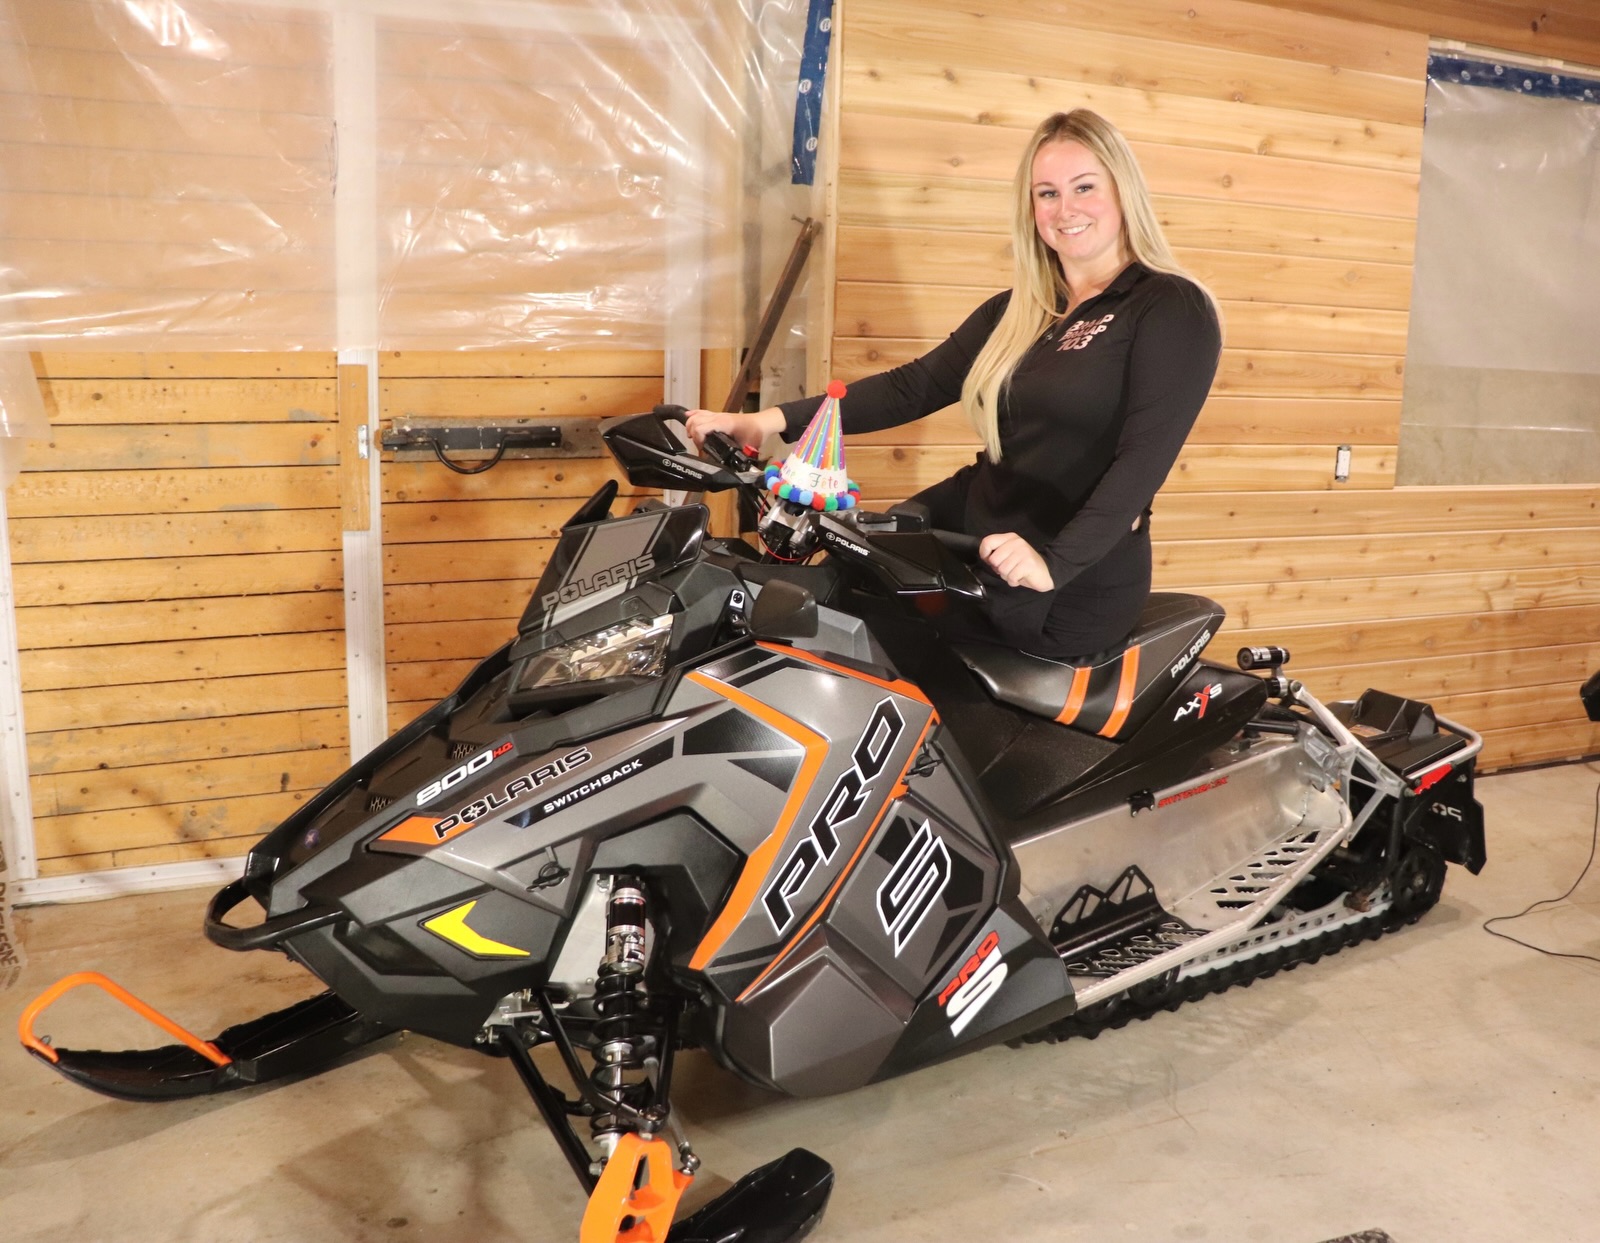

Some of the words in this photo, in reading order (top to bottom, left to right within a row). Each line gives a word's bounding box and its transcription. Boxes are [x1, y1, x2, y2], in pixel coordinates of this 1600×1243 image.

[1056, 335, 1093, 352] 103
[671, 462, 703, 480] POLARIS
[809, 472, 839, 489] Fête
[835, 536, 869, 556] POLARIS
[541, 552, 656, 612] POLARIS
[1170, 629, 1212, 678] POLARIS
[416, 749, 493, 806] 800
[433, 746, 593, 839] POLARIS
[543, 758, 643, 814] SWITCHBACK
[761, 695, 906, 936] PRO
[938, 930, 1000, 1007] PRO
[946, 946, 1008, 1037] S
